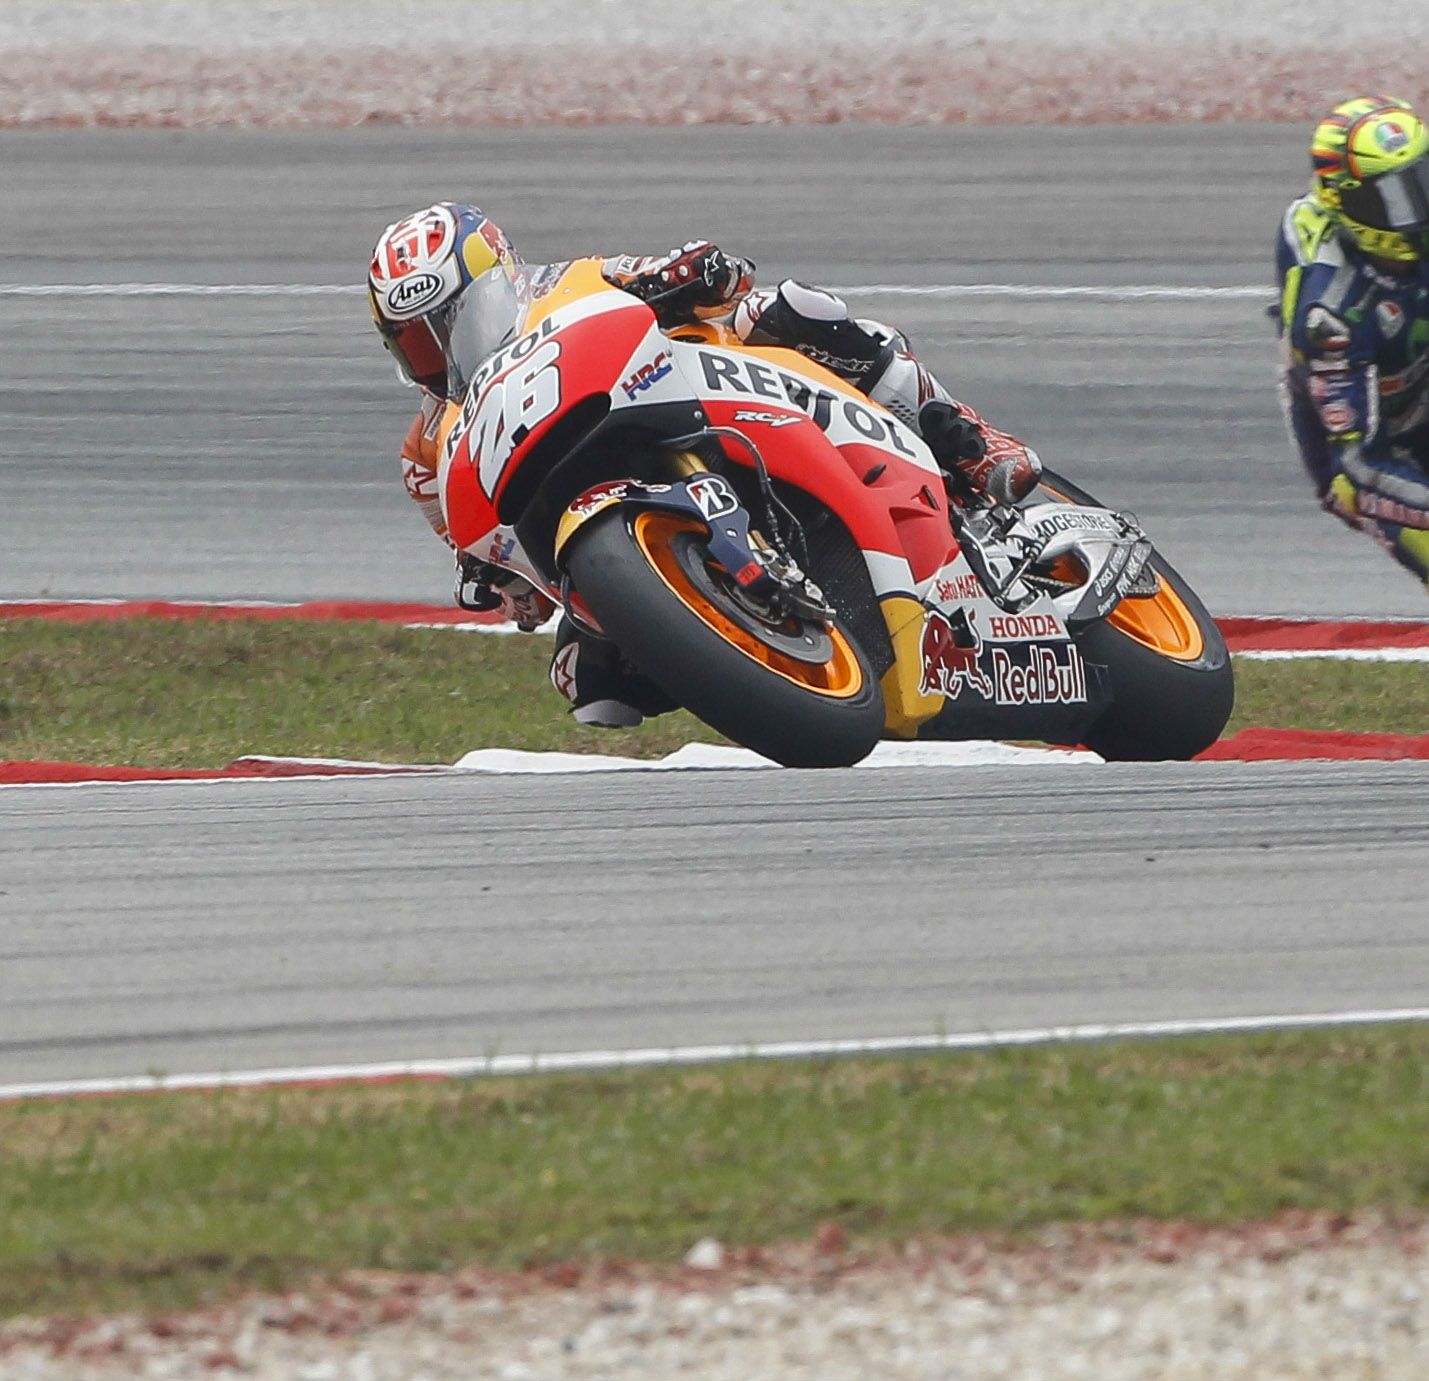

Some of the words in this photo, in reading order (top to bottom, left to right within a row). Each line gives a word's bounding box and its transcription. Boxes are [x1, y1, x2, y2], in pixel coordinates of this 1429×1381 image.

[392, 275, 433, 307] Arai
[446, 316, 561, 460] REPSOL
[620, 351, 674, 402] HRC
[698, 351, 917, 458] REPSOL
[467, 339, 563, 502] 26
[991, 614, 1062, 639] HONDA
